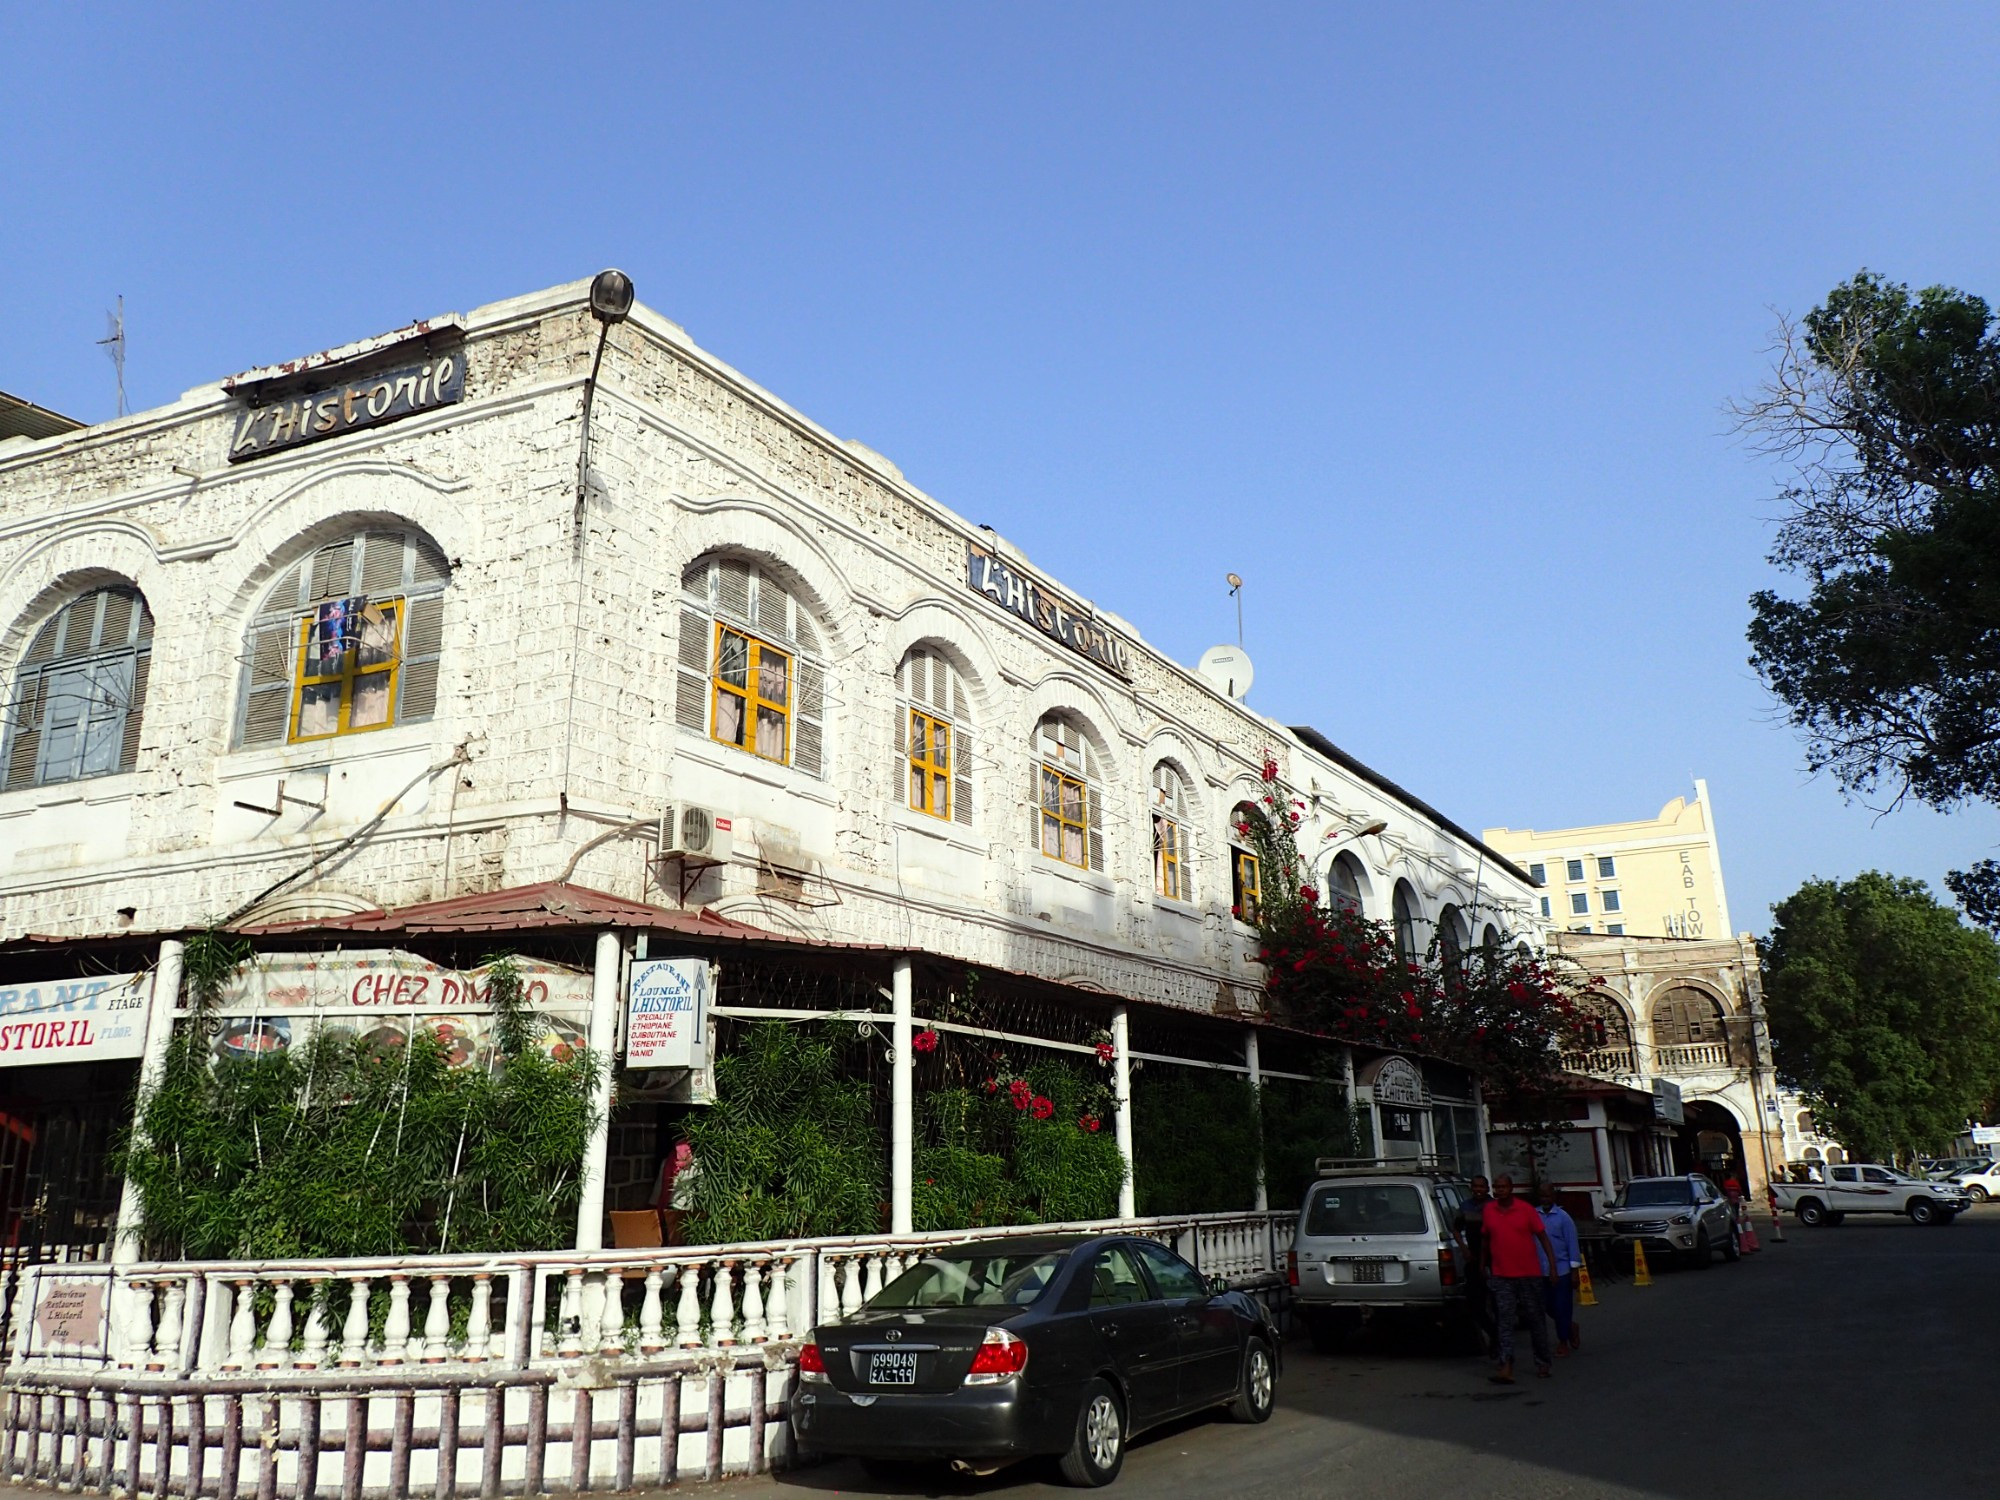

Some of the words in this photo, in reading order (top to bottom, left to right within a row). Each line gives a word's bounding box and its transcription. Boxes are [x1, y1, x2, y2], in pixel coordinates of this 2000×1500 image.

[1679, 851, 1694, 889] EAB
[1686, 897, 1703, 938] TOW
[352, 973, 430, 1006] CHEZ
[631, 962, 691, 996] RESTAURANT
[640, 986, 682, 997] LOUNGE
[107, 997, 144, 1011] ETAGE
[635, 1012, 674, 1021] SPECIALITE
[873, 1352, 915, 1368] 699D48
